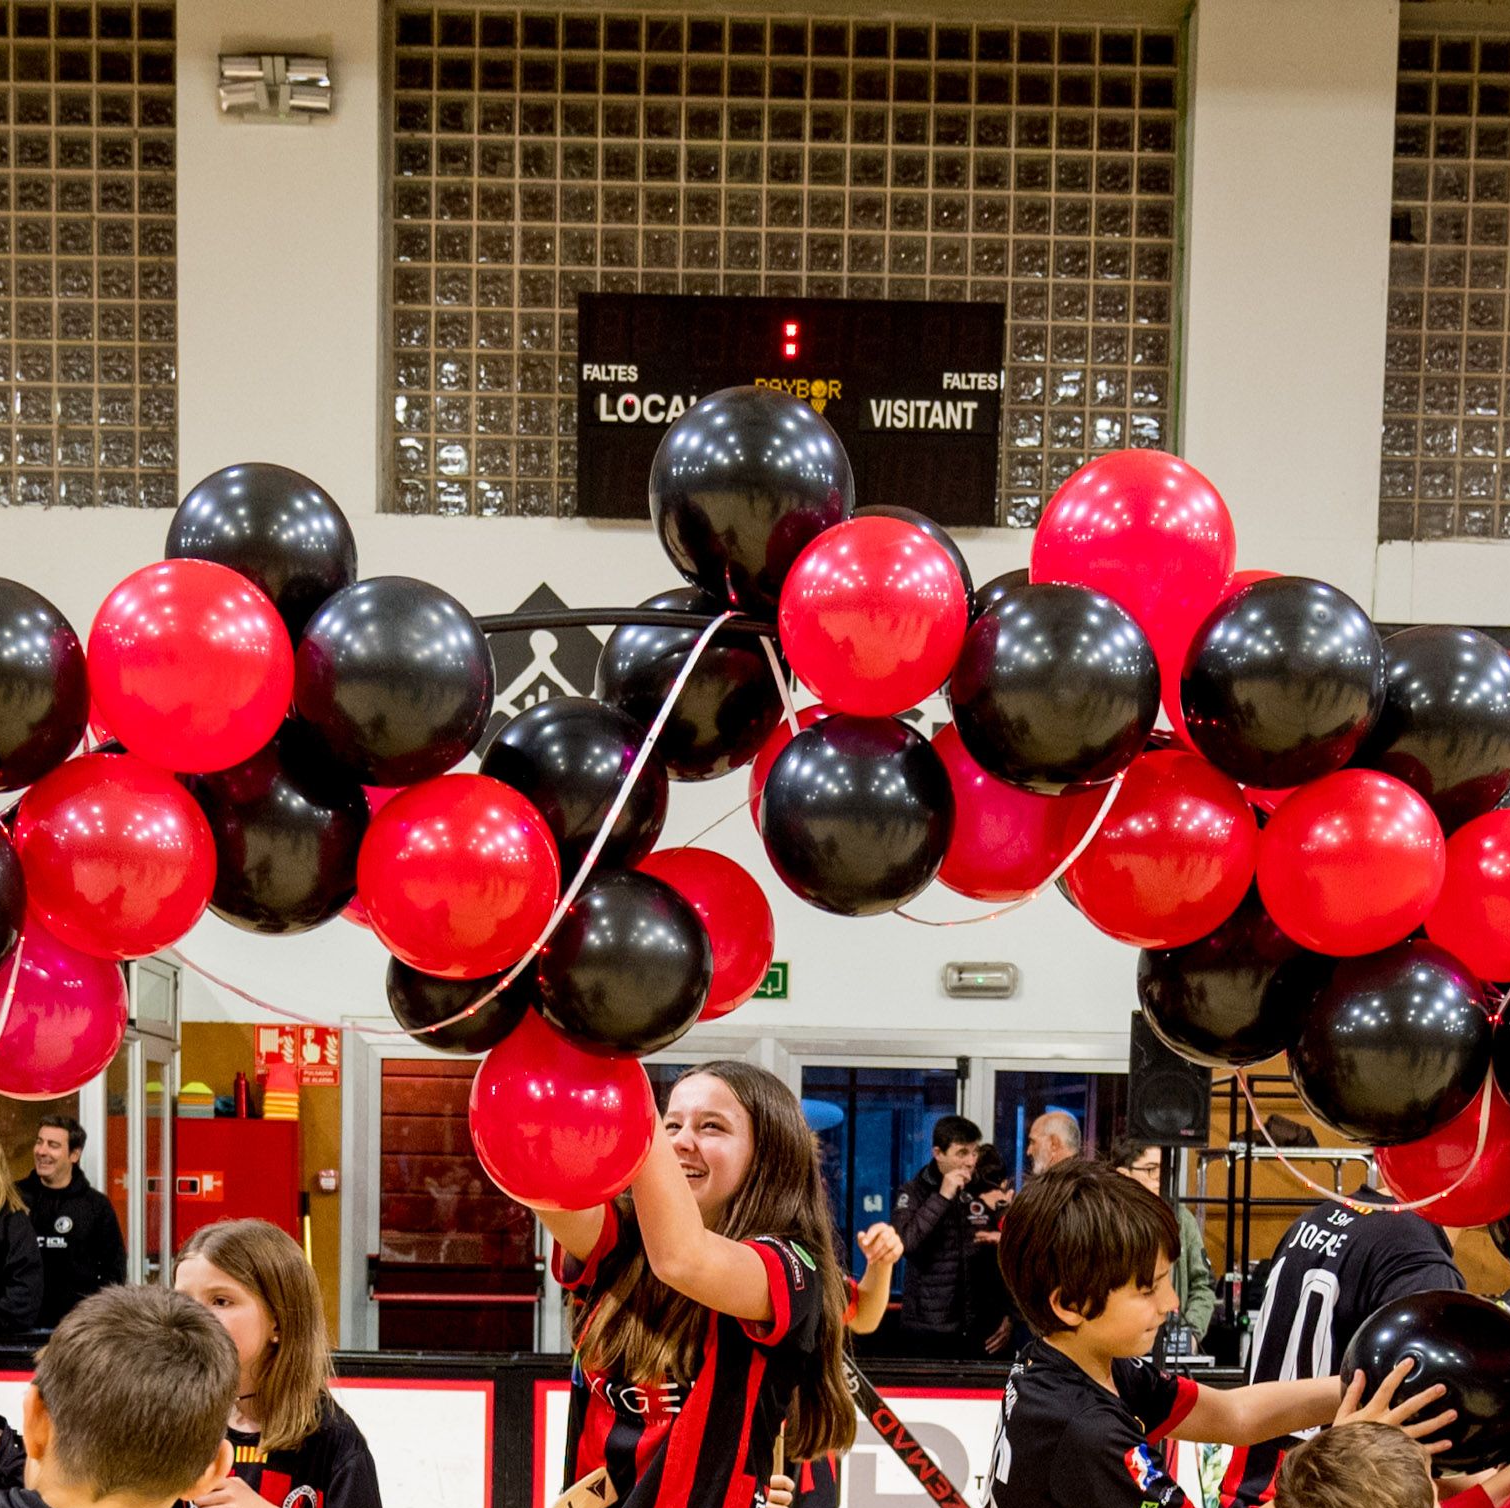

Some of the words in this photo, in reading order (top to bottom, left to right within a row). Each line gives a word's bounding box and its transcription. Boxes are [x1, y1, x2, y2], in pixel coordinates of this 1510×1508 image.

[583, 364, 638, 382] FALTES
[943, 373, 998, 390] FALTES
[599, 393, 697, 424] LOCA
[870, 399, 978, 430] VISITANT
[303, 1069, 334, 1077] PULSADOR
[1288, 1221, 1348, 1259] JOFRE
